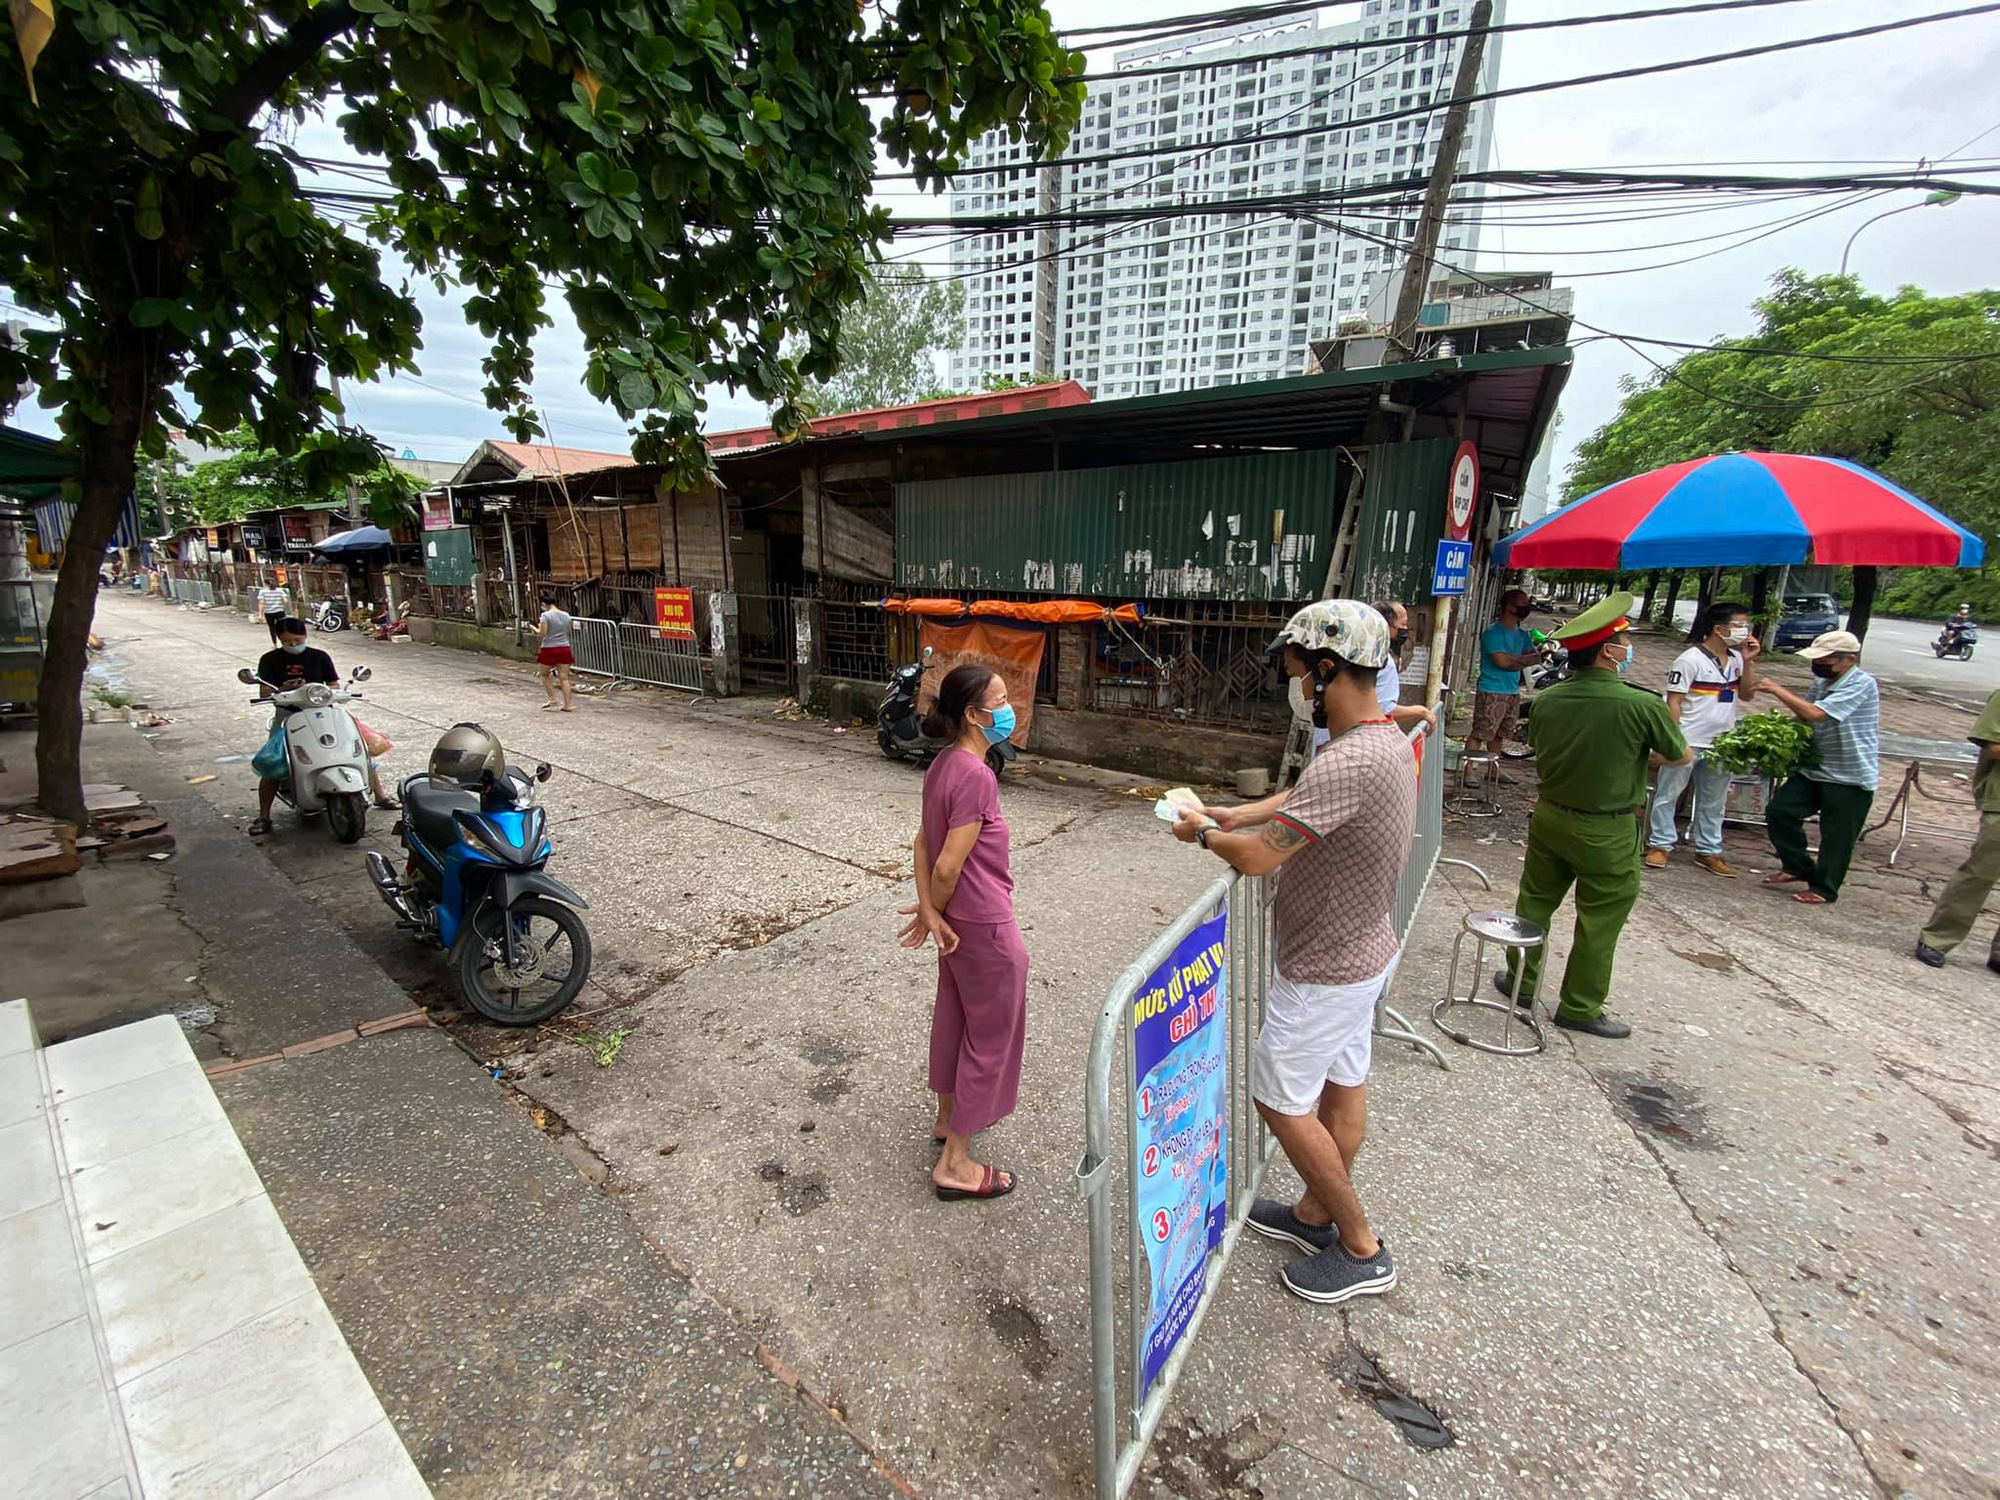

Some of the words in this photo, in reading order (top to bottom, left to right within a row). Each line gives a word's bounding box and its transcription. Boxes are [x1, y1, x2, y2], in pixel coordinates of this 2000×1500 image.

[1446, 547, 1465, 569] CẤM
[1134, 988, 1167, 1029] MỨC
[1182, 951, 1214, 992] PHẠT
[1170, 994, 1198, 1043] CHỈ
[1155, 1210, 1170, 1239] 3
